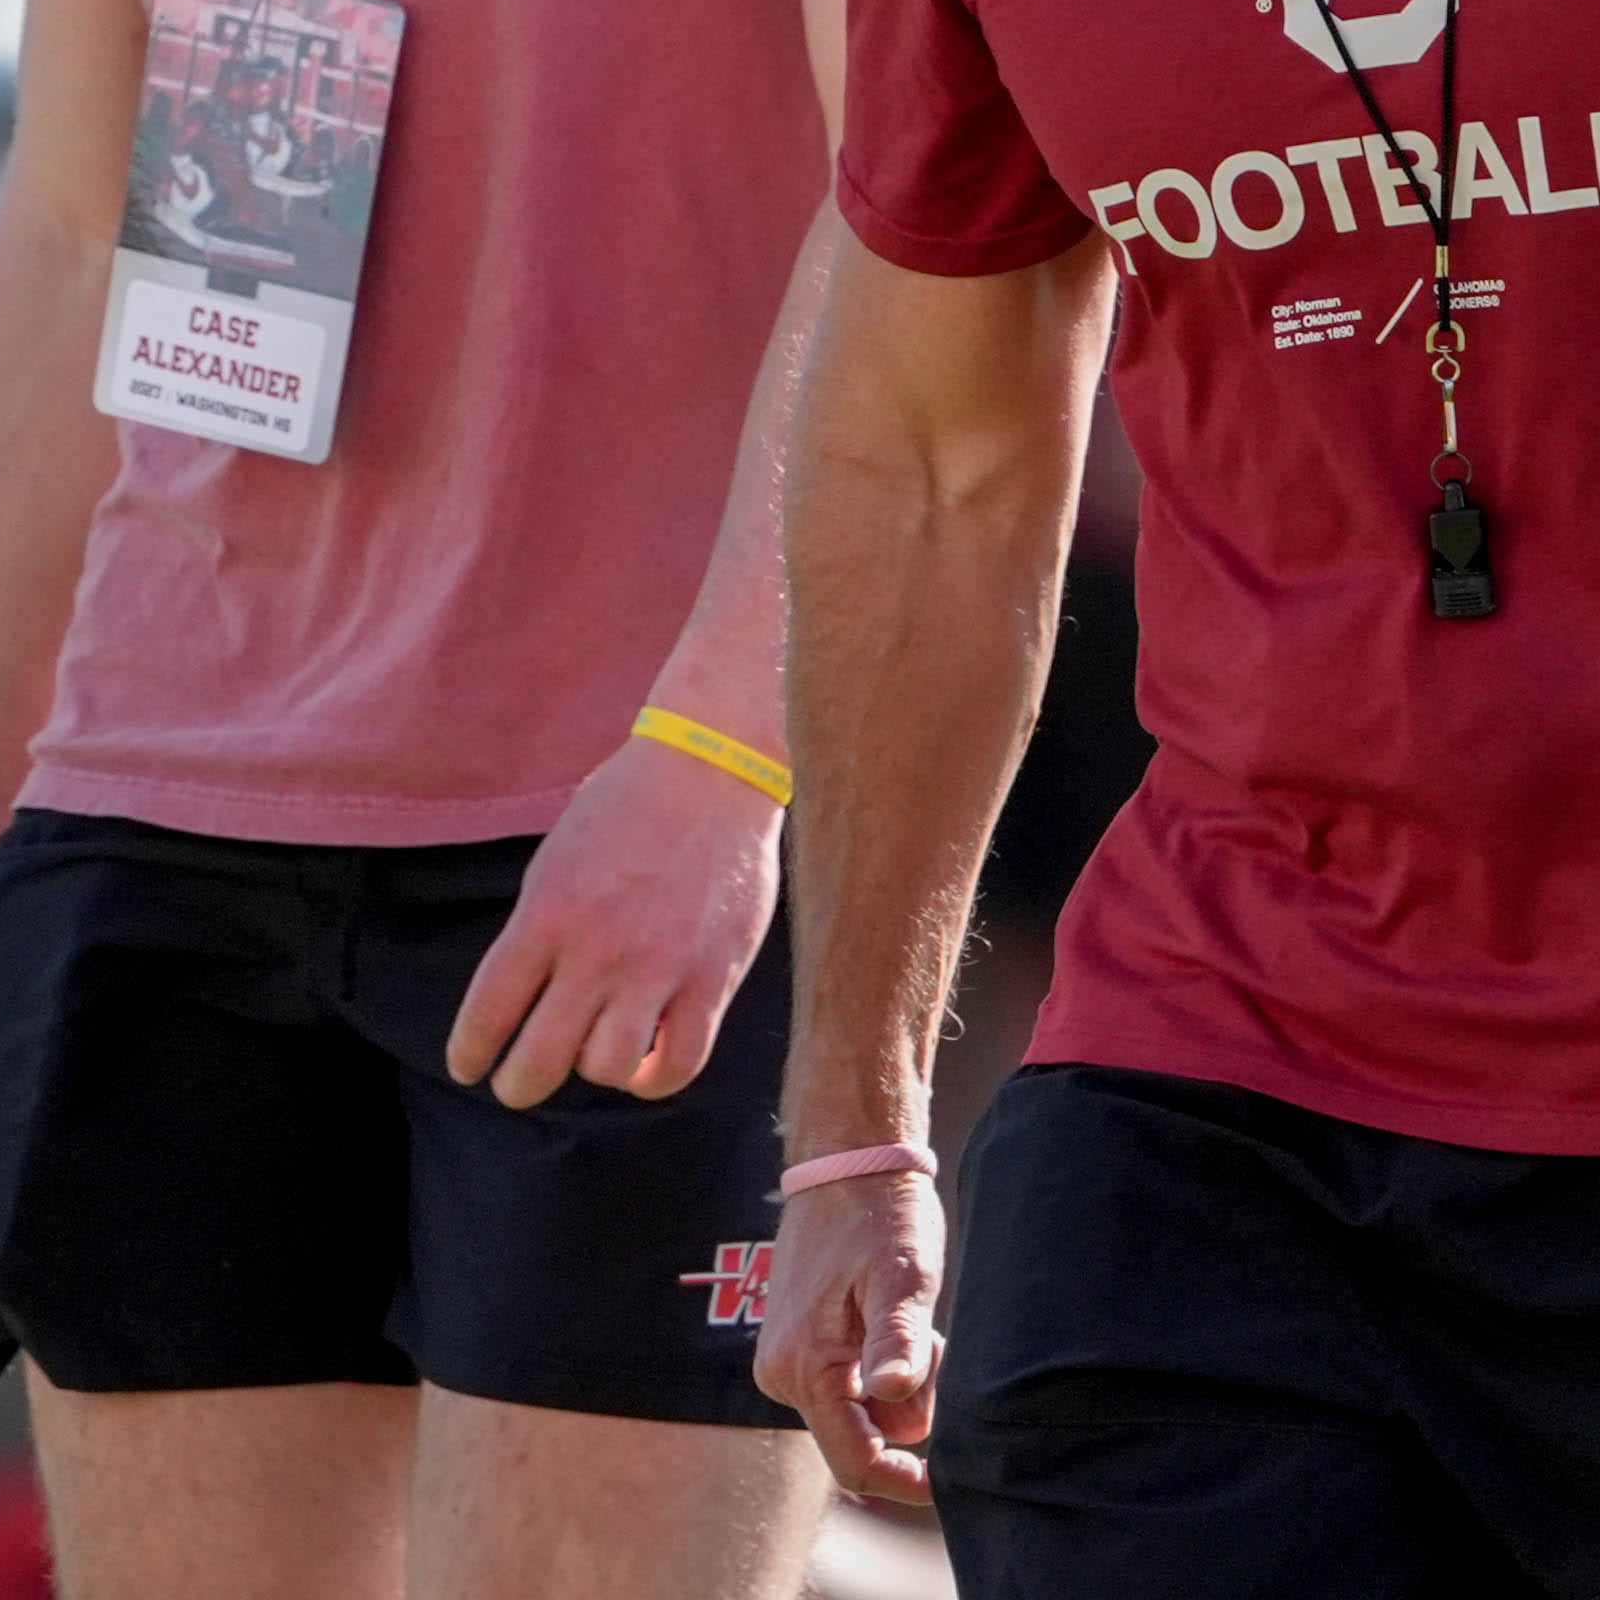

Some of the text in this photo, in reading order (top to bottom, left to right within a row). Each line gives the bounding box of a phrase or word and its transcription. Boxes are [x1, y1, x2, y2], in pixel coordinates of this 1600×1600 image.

[1295, 297, 1341, 313] Norman
[1303, 309, 1362, 327] Oklahoma
[188, 305, 260, 348] CASE
[1326, 325, 1355, 340] 1890
[132, 336, 301, 403] ALEXANDER
[176, 390, 268, 428] WASHINGTON
